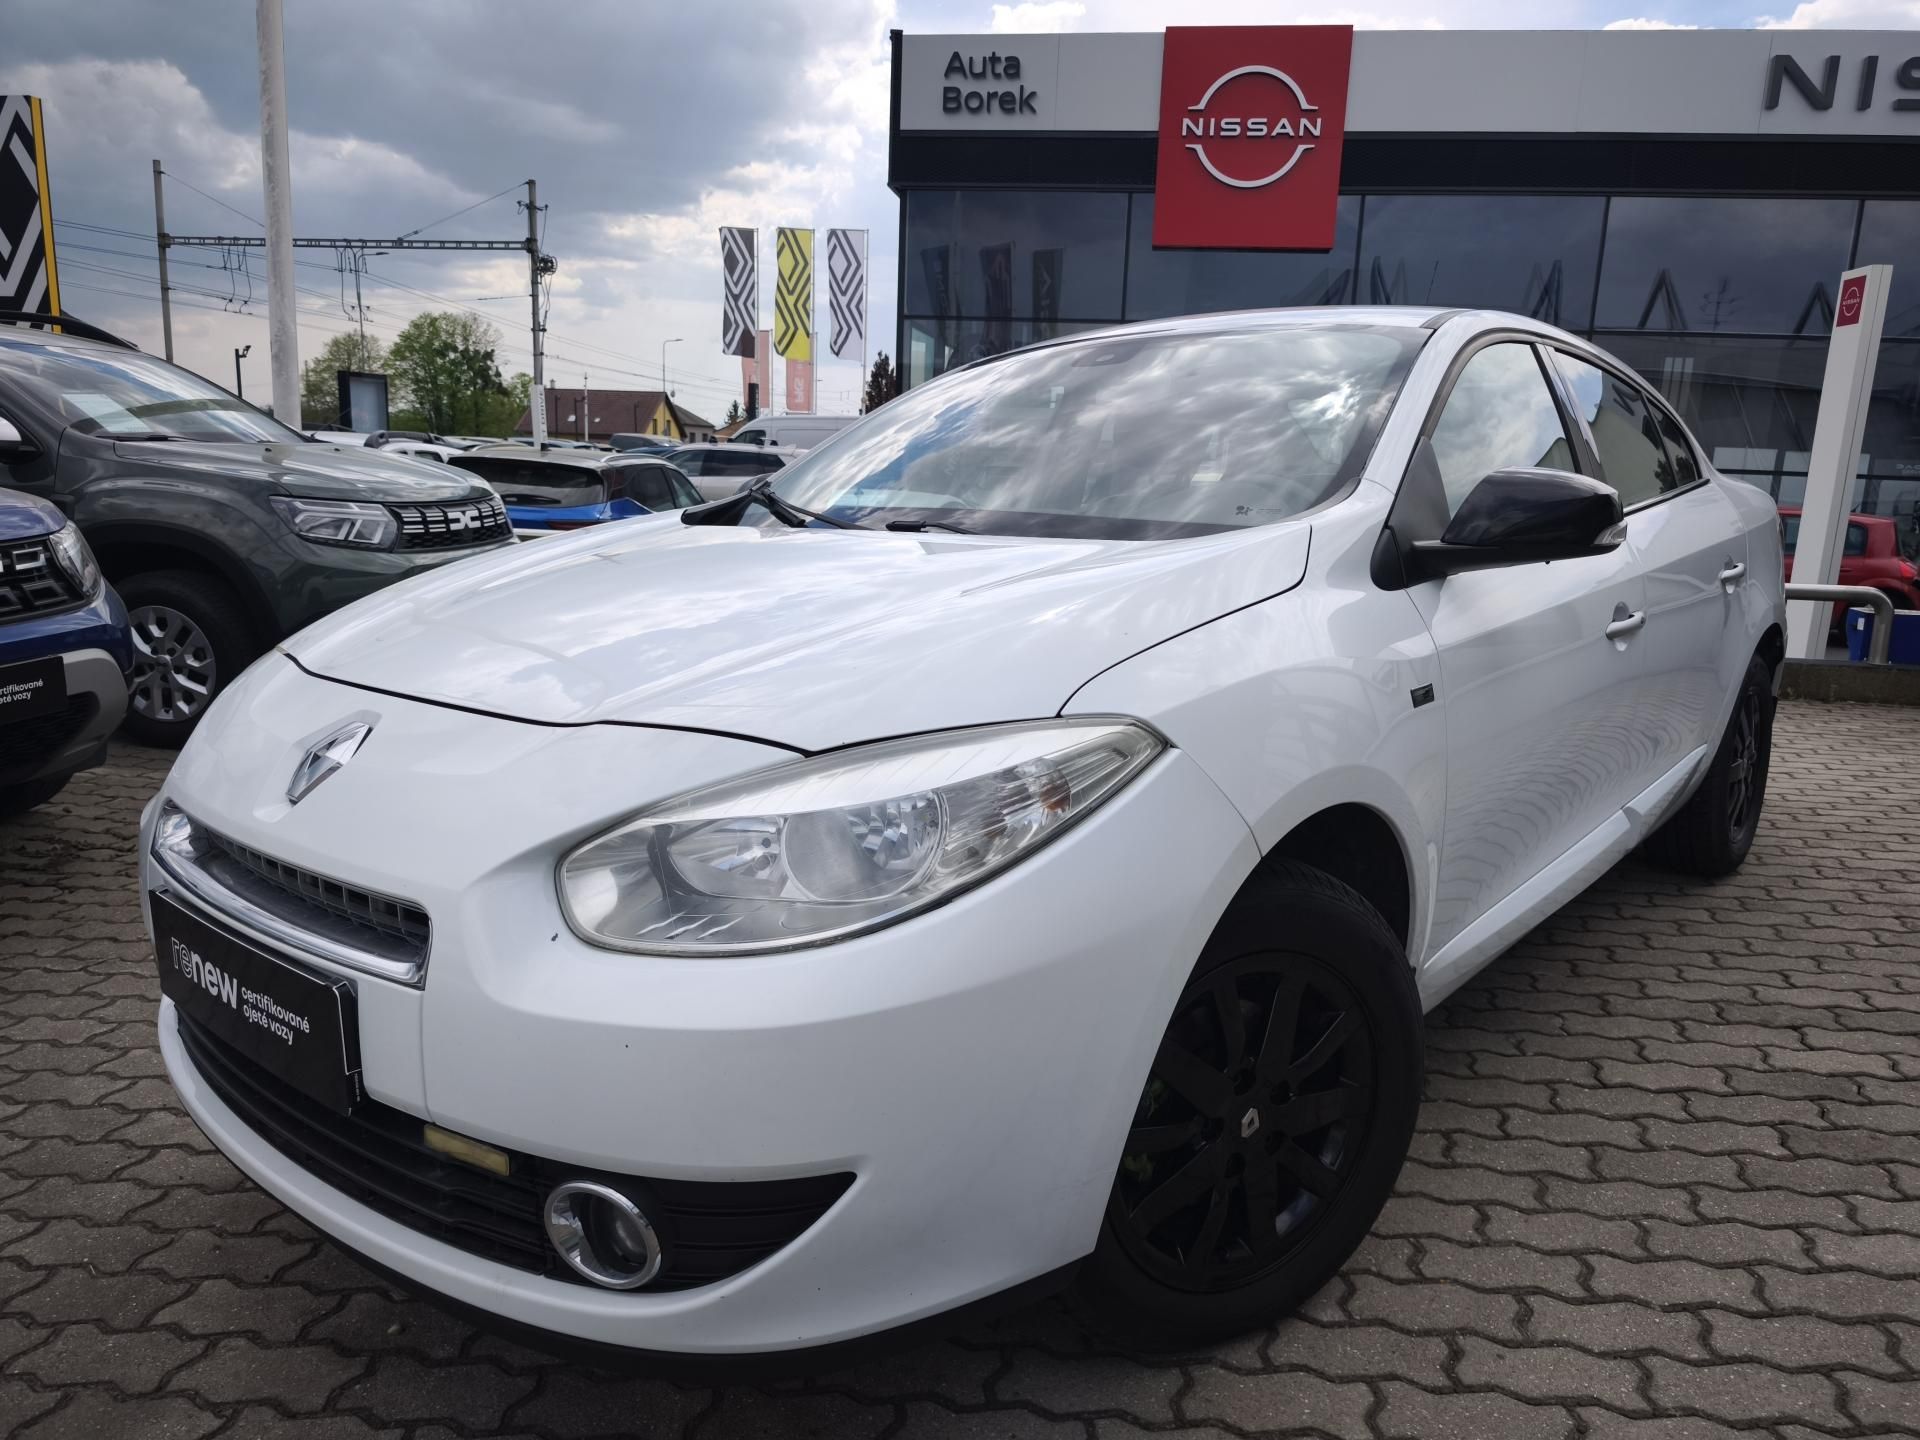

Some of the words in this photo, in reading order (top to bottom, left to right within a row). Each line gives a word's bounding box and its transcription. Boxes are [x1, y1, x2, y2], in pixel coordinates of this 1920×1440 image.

[944, 50, 1021, 79] Auta
[942, 84, 1037, 115] Borek
[1181, 116, 1322, 138] NISSAN
[12, 690, 32, 700] vozy
[171, 936, 238, 1010] renew
[241, 986, 310, 1033] certifikované
[243, 1004, 269, 1029] ojeté
[269, 1021, 294, 1046] vozy
